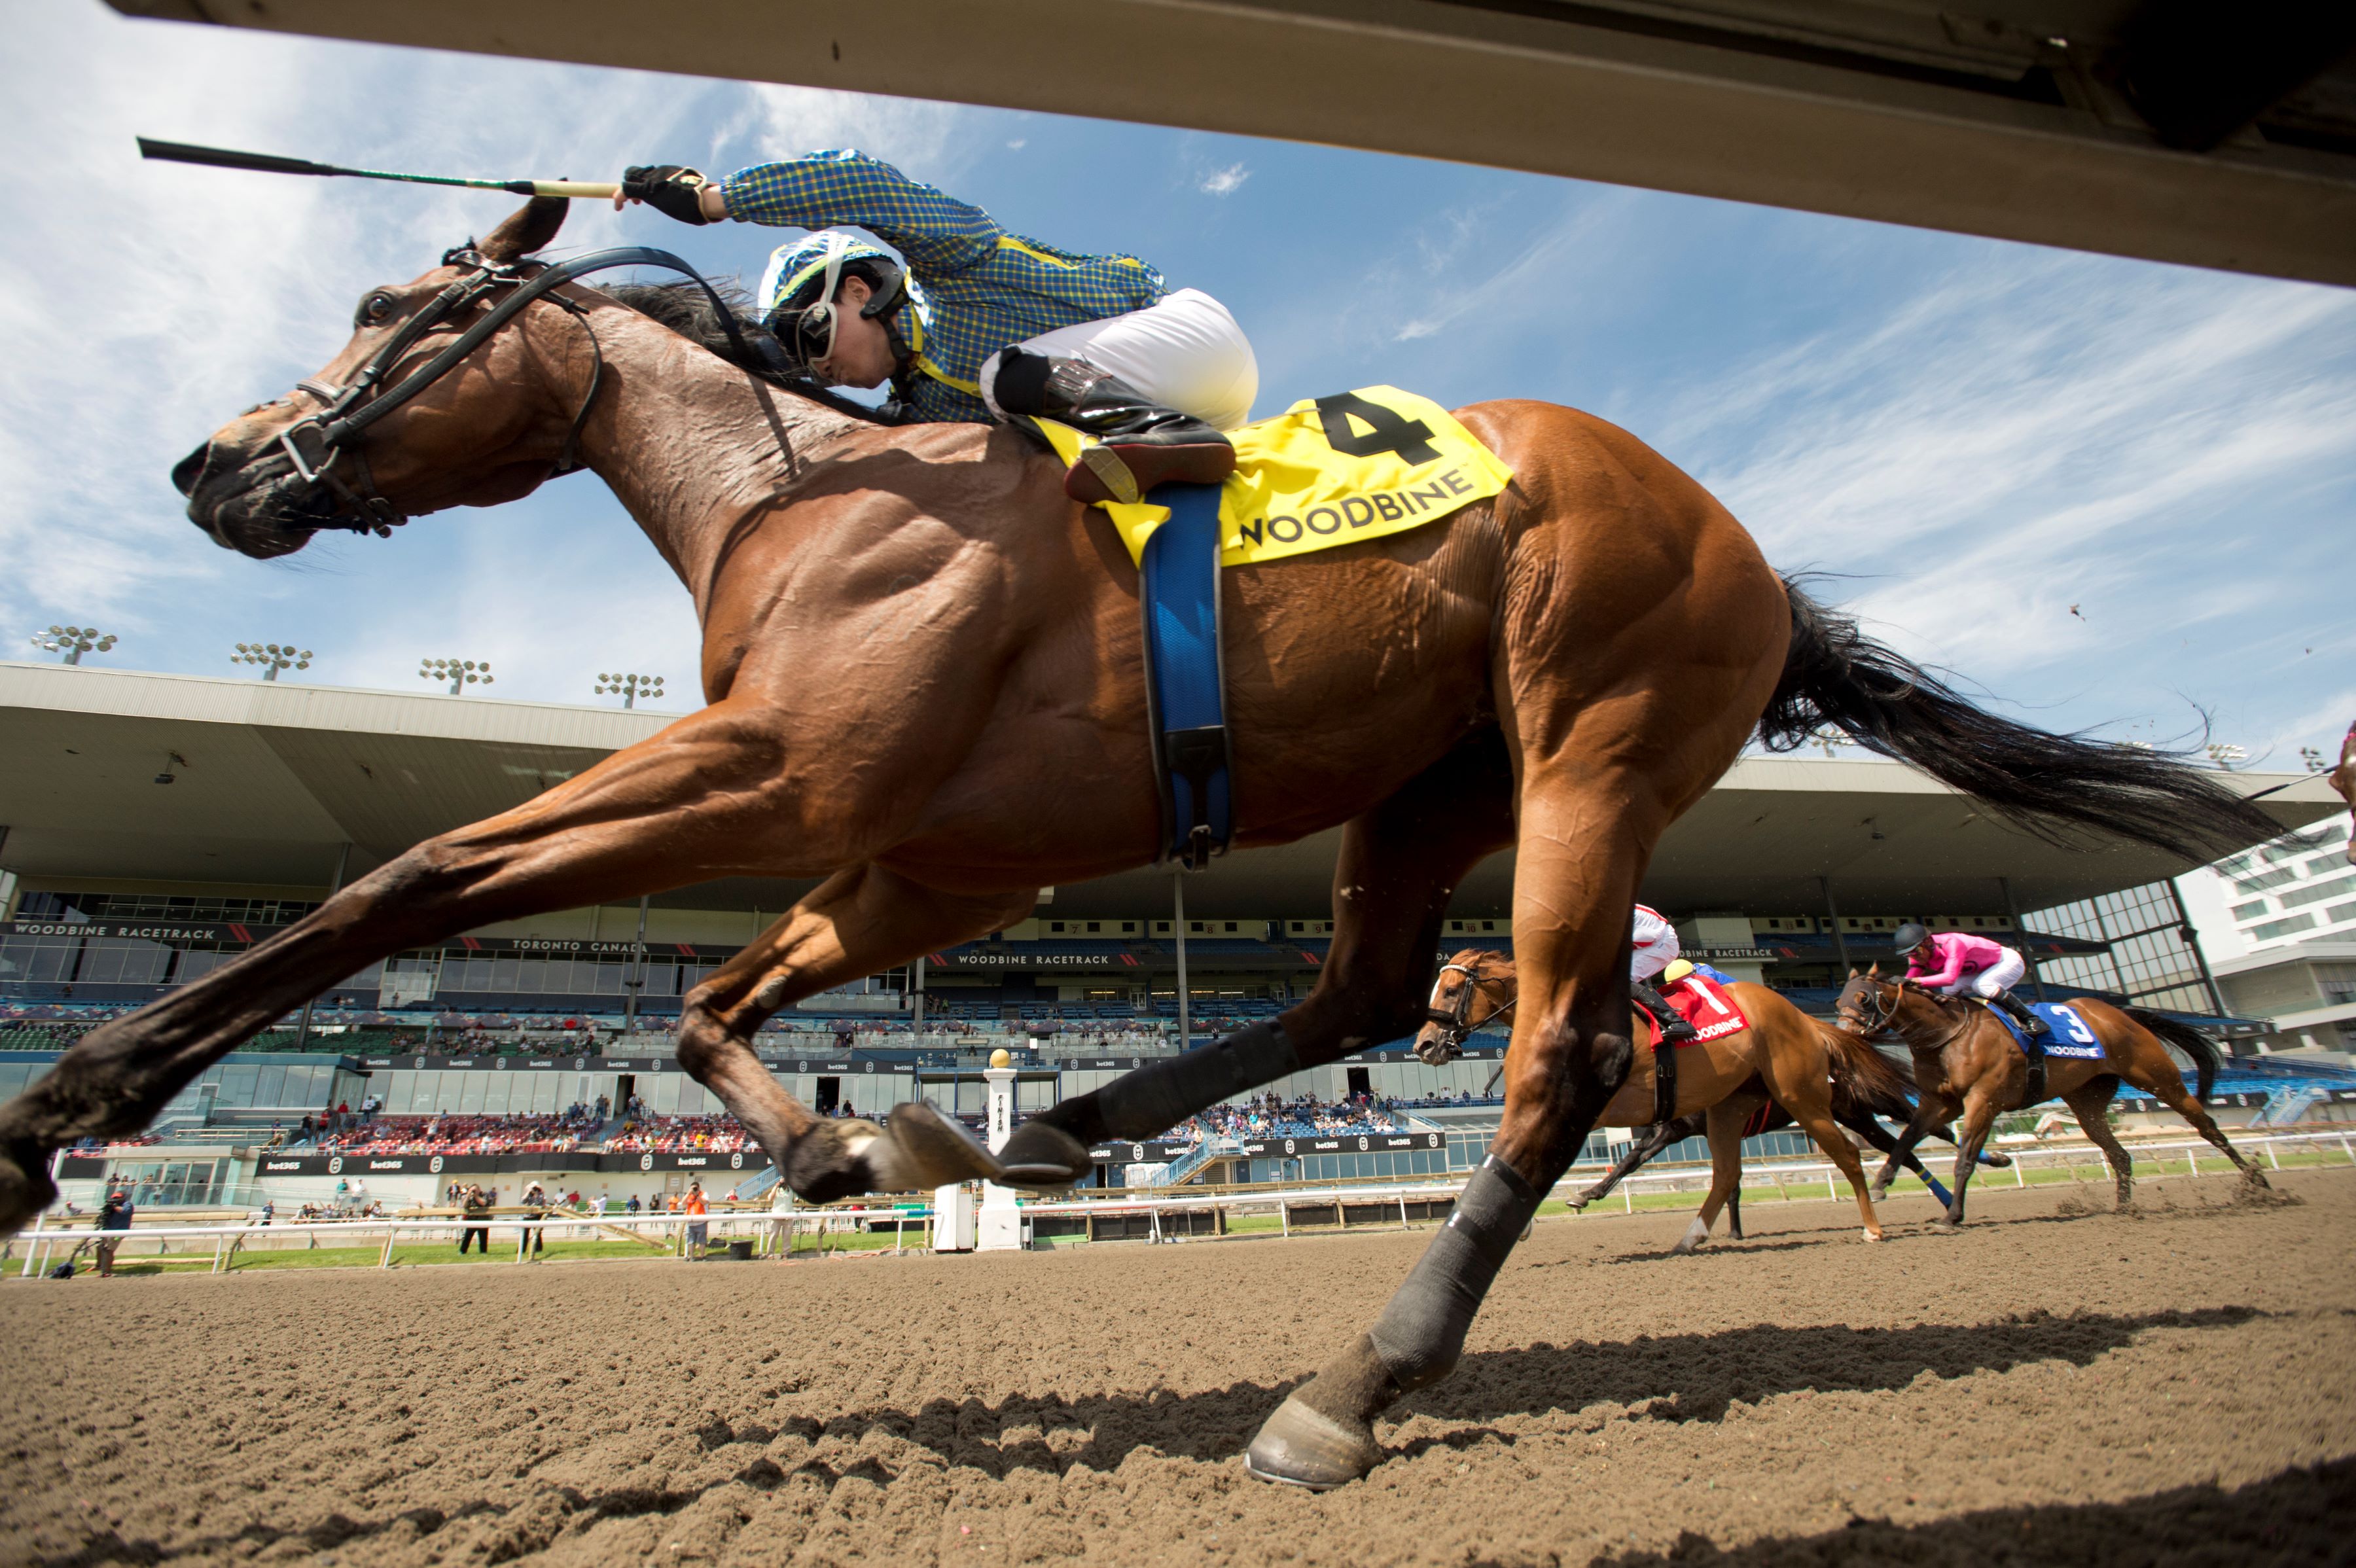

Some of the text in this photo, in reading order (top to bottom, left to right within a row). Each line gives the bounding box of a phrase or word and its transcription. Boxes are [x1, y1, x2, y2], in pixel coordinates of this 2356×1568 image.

[1315, 391, 1444, 466] 4
[14, 924, 215, 939] WOODBINE RACETRACK
[513, 940, 580, 950] TORONTO
[1715, 949, 1772, 957] RACETRACK
[959, 955, 1109, 964] WOODBINE RACETRACK
[1683, 978, 1730, 1014] 1
[1684, 1016, 1743, 1043] OODBINE
[2050, 1005, 2094, 1042] 3
[2044, 1045, 2099, 1057] WOODBINE
[267, 1162, 300, 1170] bet365
[370, 1160, 402, 1169] bet365
